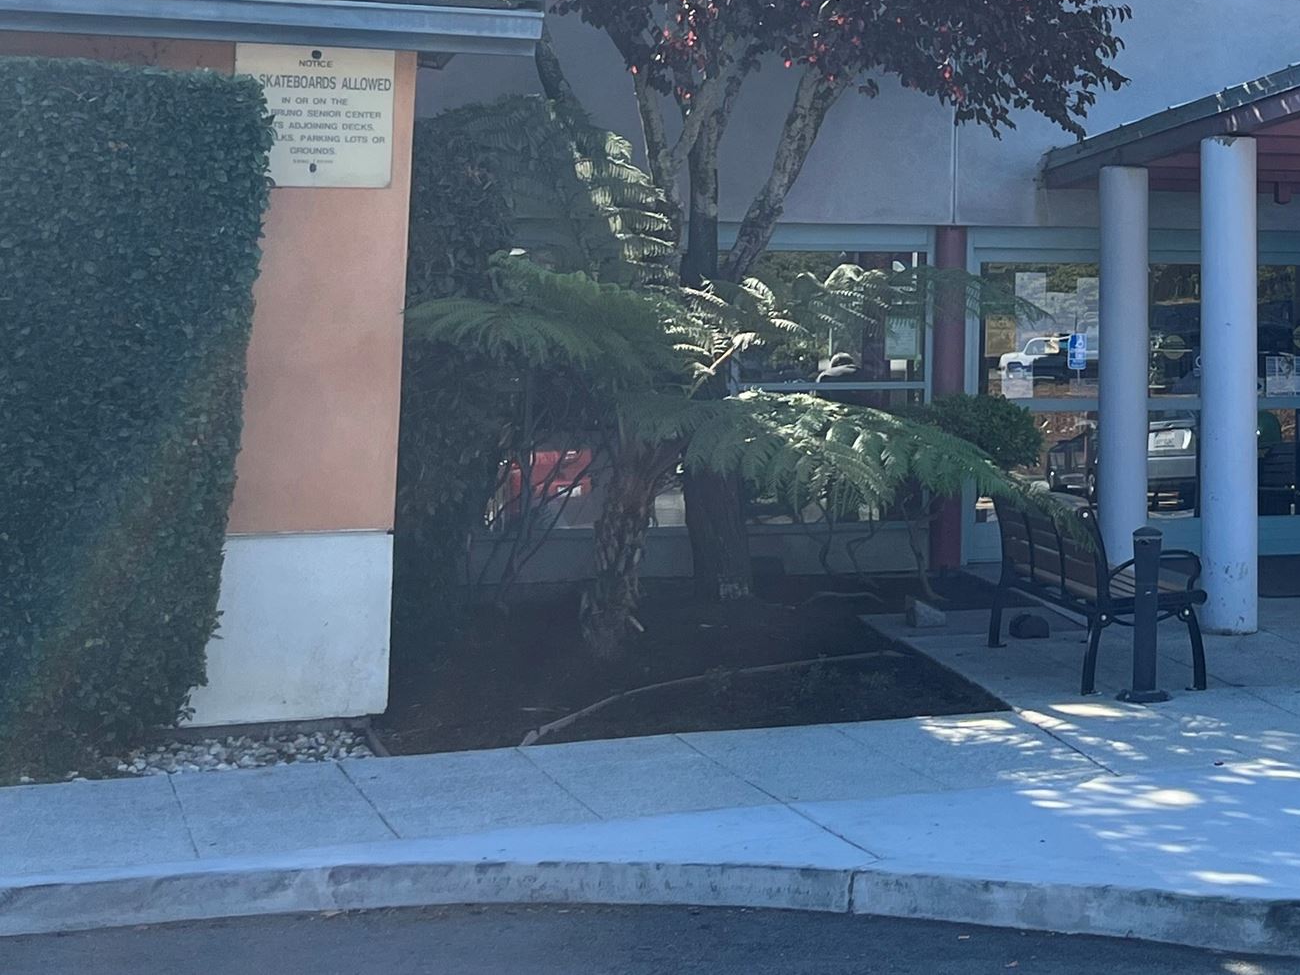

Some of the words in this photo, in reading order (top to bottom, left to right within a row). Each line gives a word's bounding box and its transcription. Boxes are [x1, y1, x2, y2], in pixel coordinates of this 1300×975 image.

[299, 60, 334, 68] NOTICE
[259, 74, 336, 90] SKATEBOARDS
[341, 77, 392, 92] ALLOWED
[345, 111, 382, 119] CENTER
[289, 122, 338, 130] ADJOINING
[372, 136, 385, 144] OR
